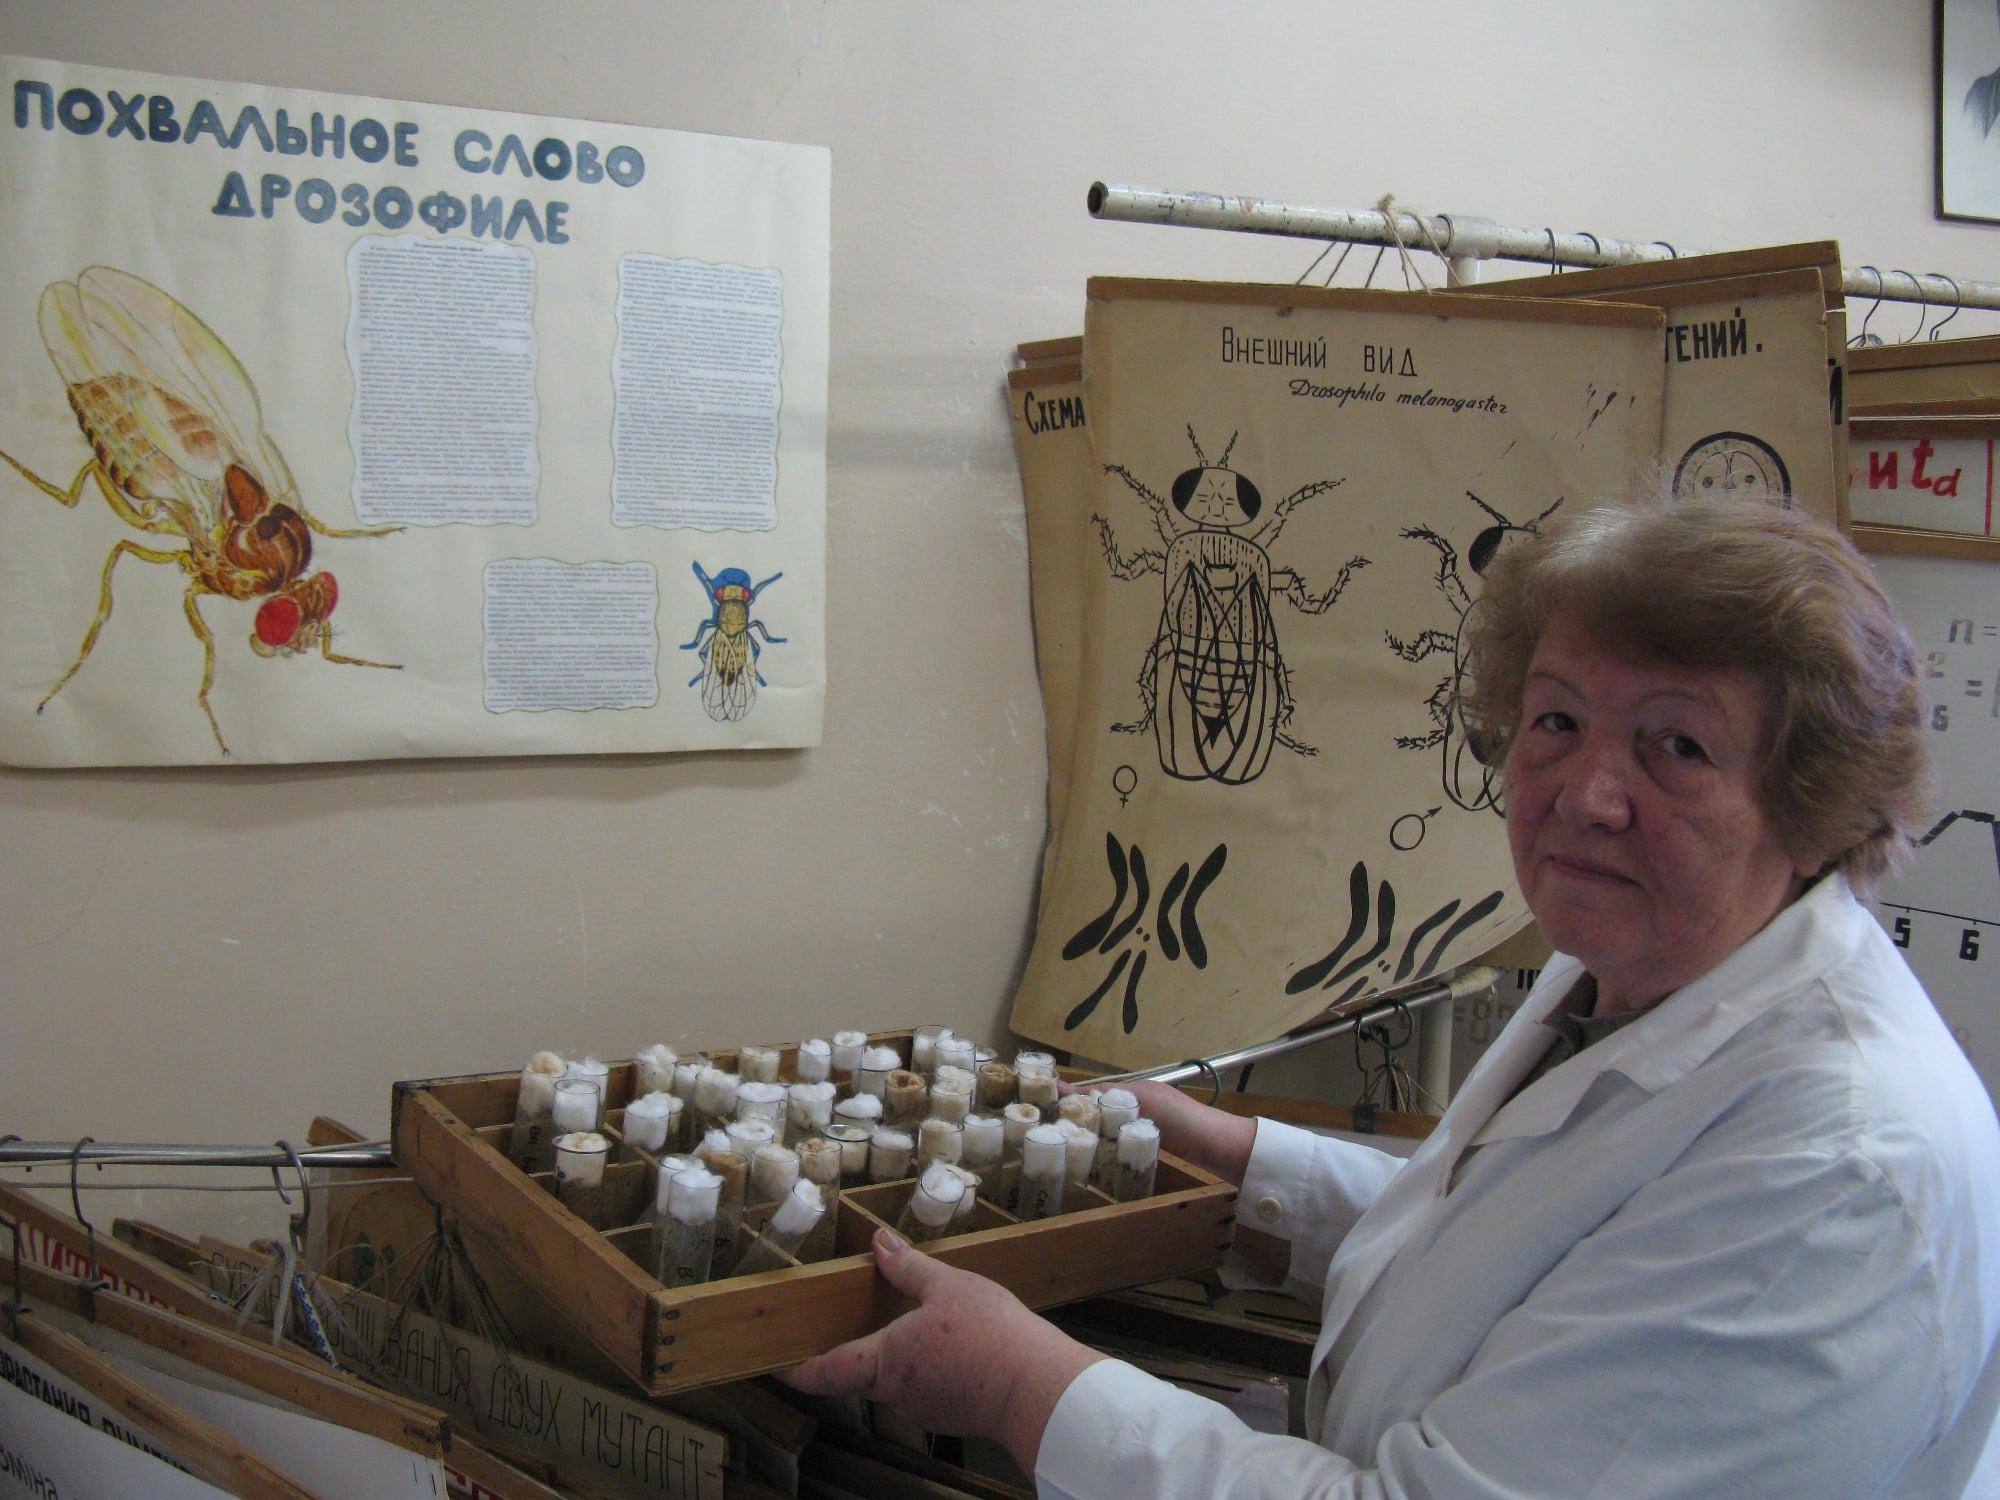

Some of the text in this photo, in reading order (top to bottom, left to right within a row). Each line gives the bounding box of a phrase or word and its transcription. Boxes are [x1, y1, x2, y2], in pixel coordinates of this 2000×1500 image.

[13, 78, 646, 188] ПОХВАЛЬНОЕ СЛОВО
[211, 170, 570, 245] ДРОЗОФИЛЕ
[1364, 345, 1419, 378] ВИД
[1289, 378, 1508, 416] Drosophila melanogaster
[1959, 929, 1979, 962] 6
